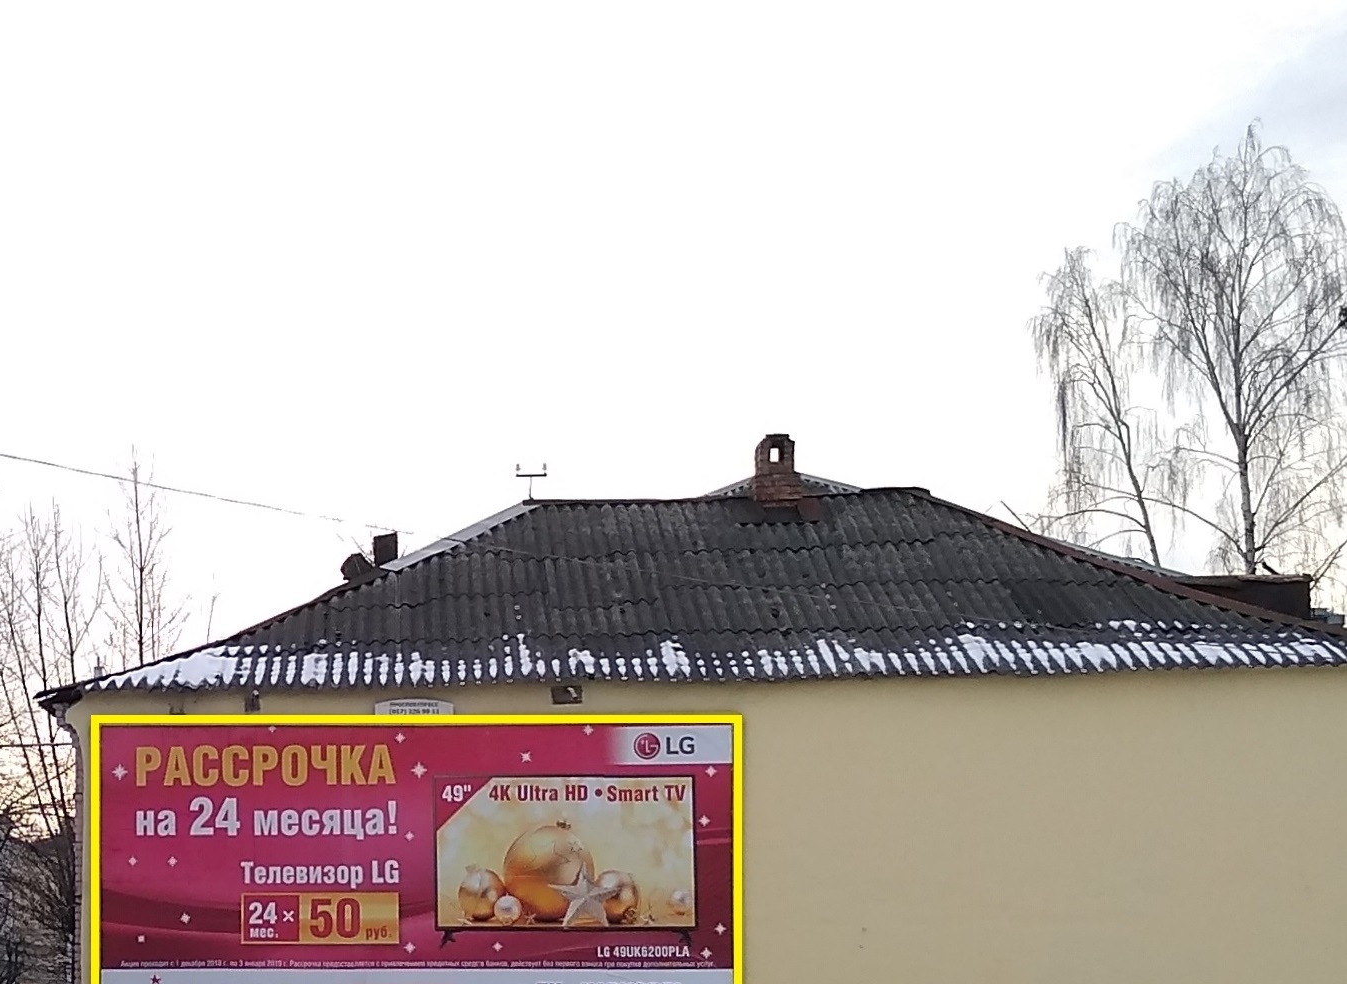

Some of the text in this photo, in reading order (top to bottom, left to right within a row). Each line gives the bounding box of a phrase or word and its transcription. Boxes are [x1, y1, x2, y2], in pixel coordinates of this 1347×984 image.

[666, 736, 695, 755] LG
[135, 744, 397, 787] РАССРОЧКА
[442, 784, 686, 802] 49" 4K Ultra HD Smart TV
[135, 796, 398, 840] на 24 месяца!
[240, 859, 400, 889] Телевизор LG
[248, 902, 277, 925] 24
[309, 897, 362, 939] 50
[366, 925, 393, 940] руб.
[250, 928, 279, 938] мес.
[597, 945, 690, 958] LG 49UK6200PLA
